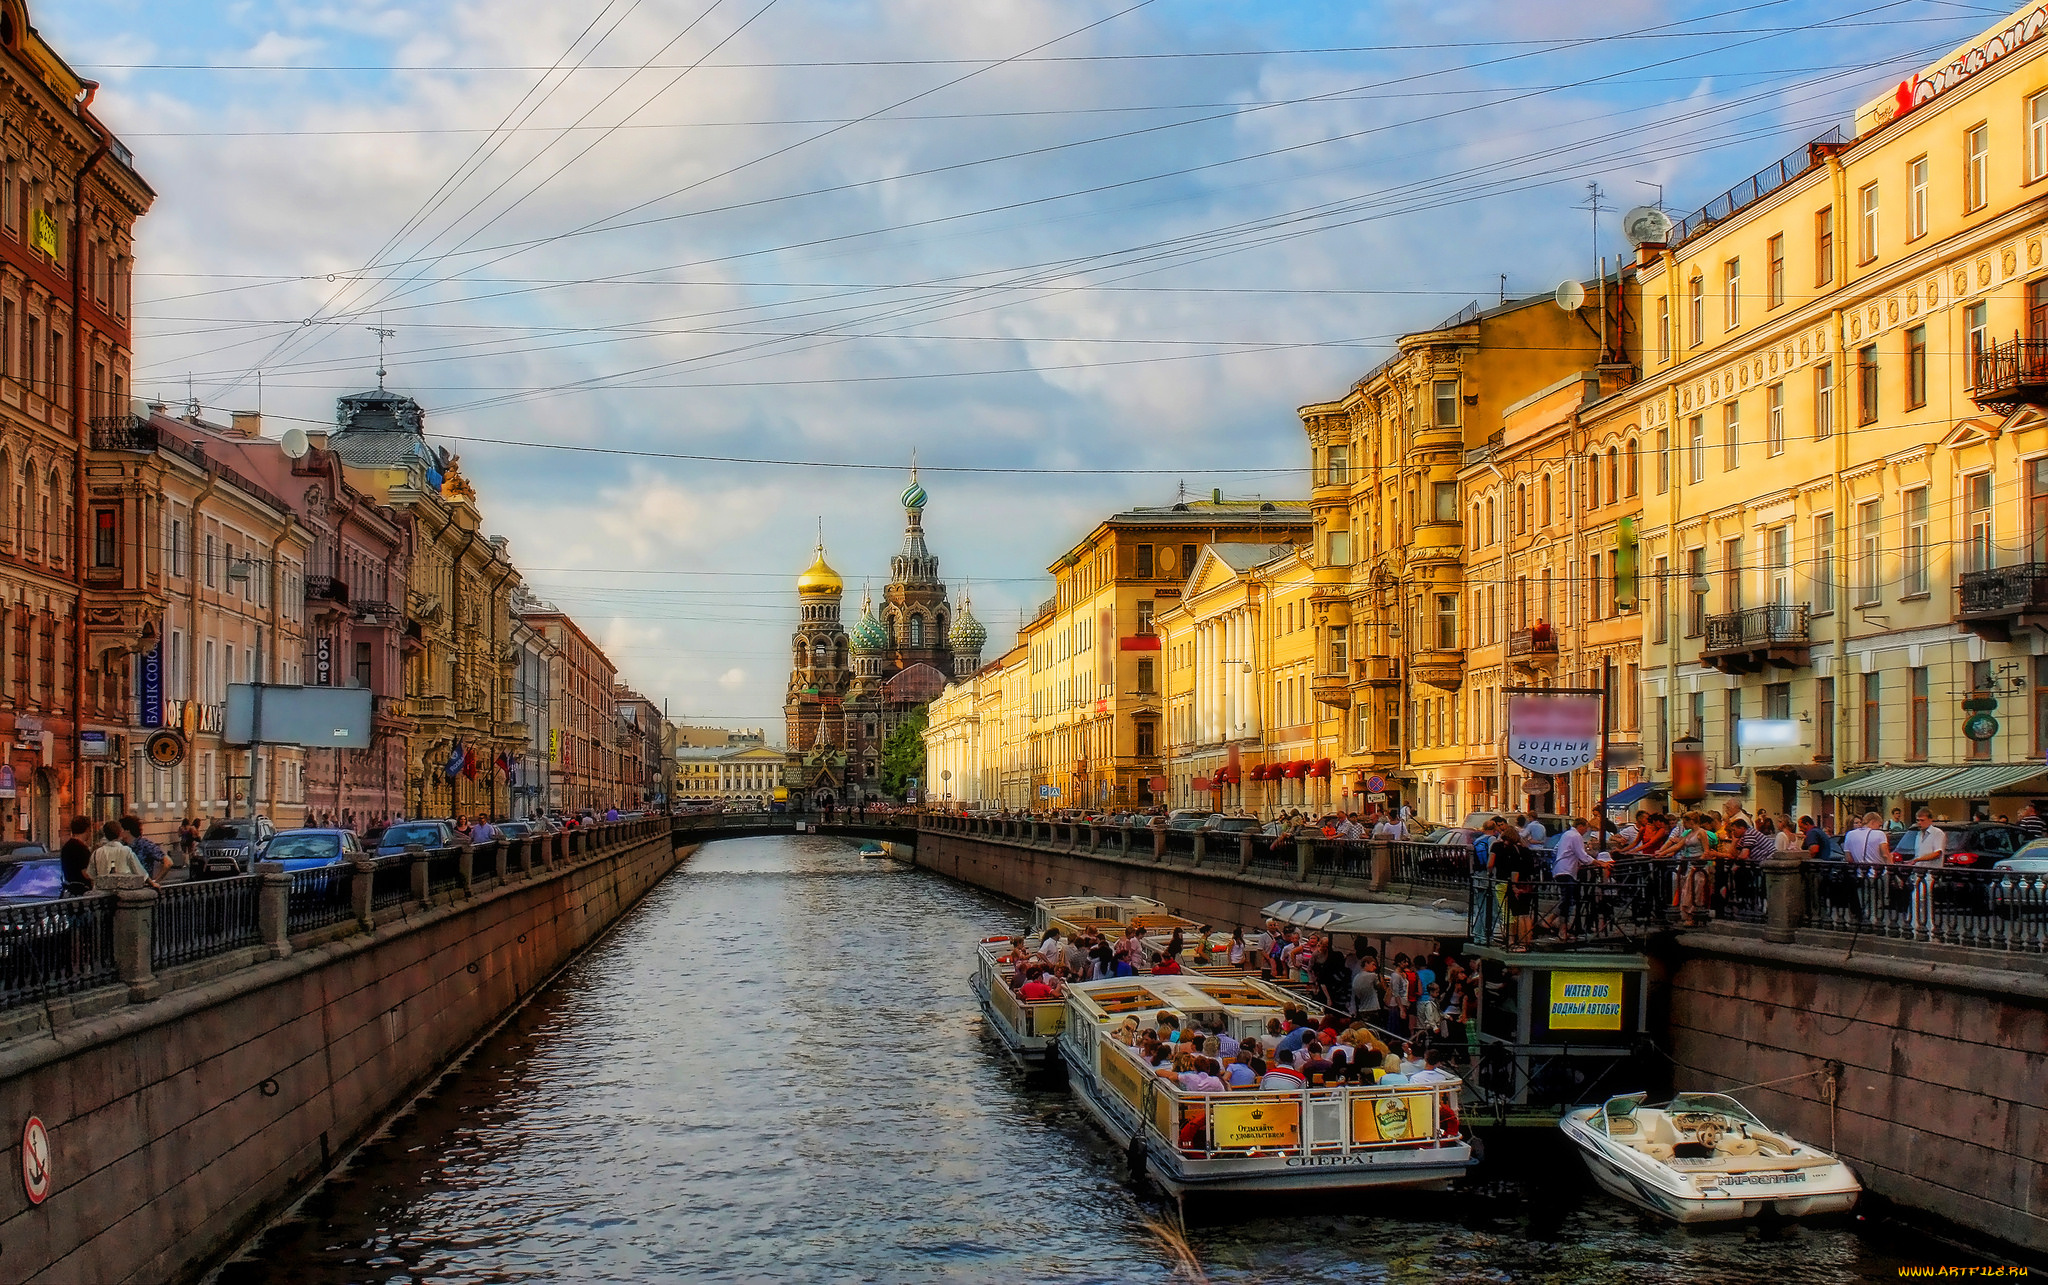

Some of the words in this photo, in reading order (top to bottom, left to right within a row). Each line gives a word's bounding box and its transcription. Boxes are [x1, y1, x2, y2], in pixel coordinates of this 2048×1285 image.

[318, 638, 329, 682] КОФЕ
[146, 684, 158, 723] БАНК
[1517, 753, 1590, 767] АВТОБУС
[1564, 984, 1591, 997] WATER
[1592, 985, 1609, 997] BUS
[1552, 1001, 1586, 1016] ВОДНЫЙ
[1586, 1003, 1620, 1015] АВТОБУС
[1238, 1124, 1274, 1132] Отдыхайте
[1235, 1132, 1285, 1140] удовольствием
[1285, 1154, 1364, 1166] СИЕРРА
[1718, 1172, 1806, 1186] МИРОСЛАВА
